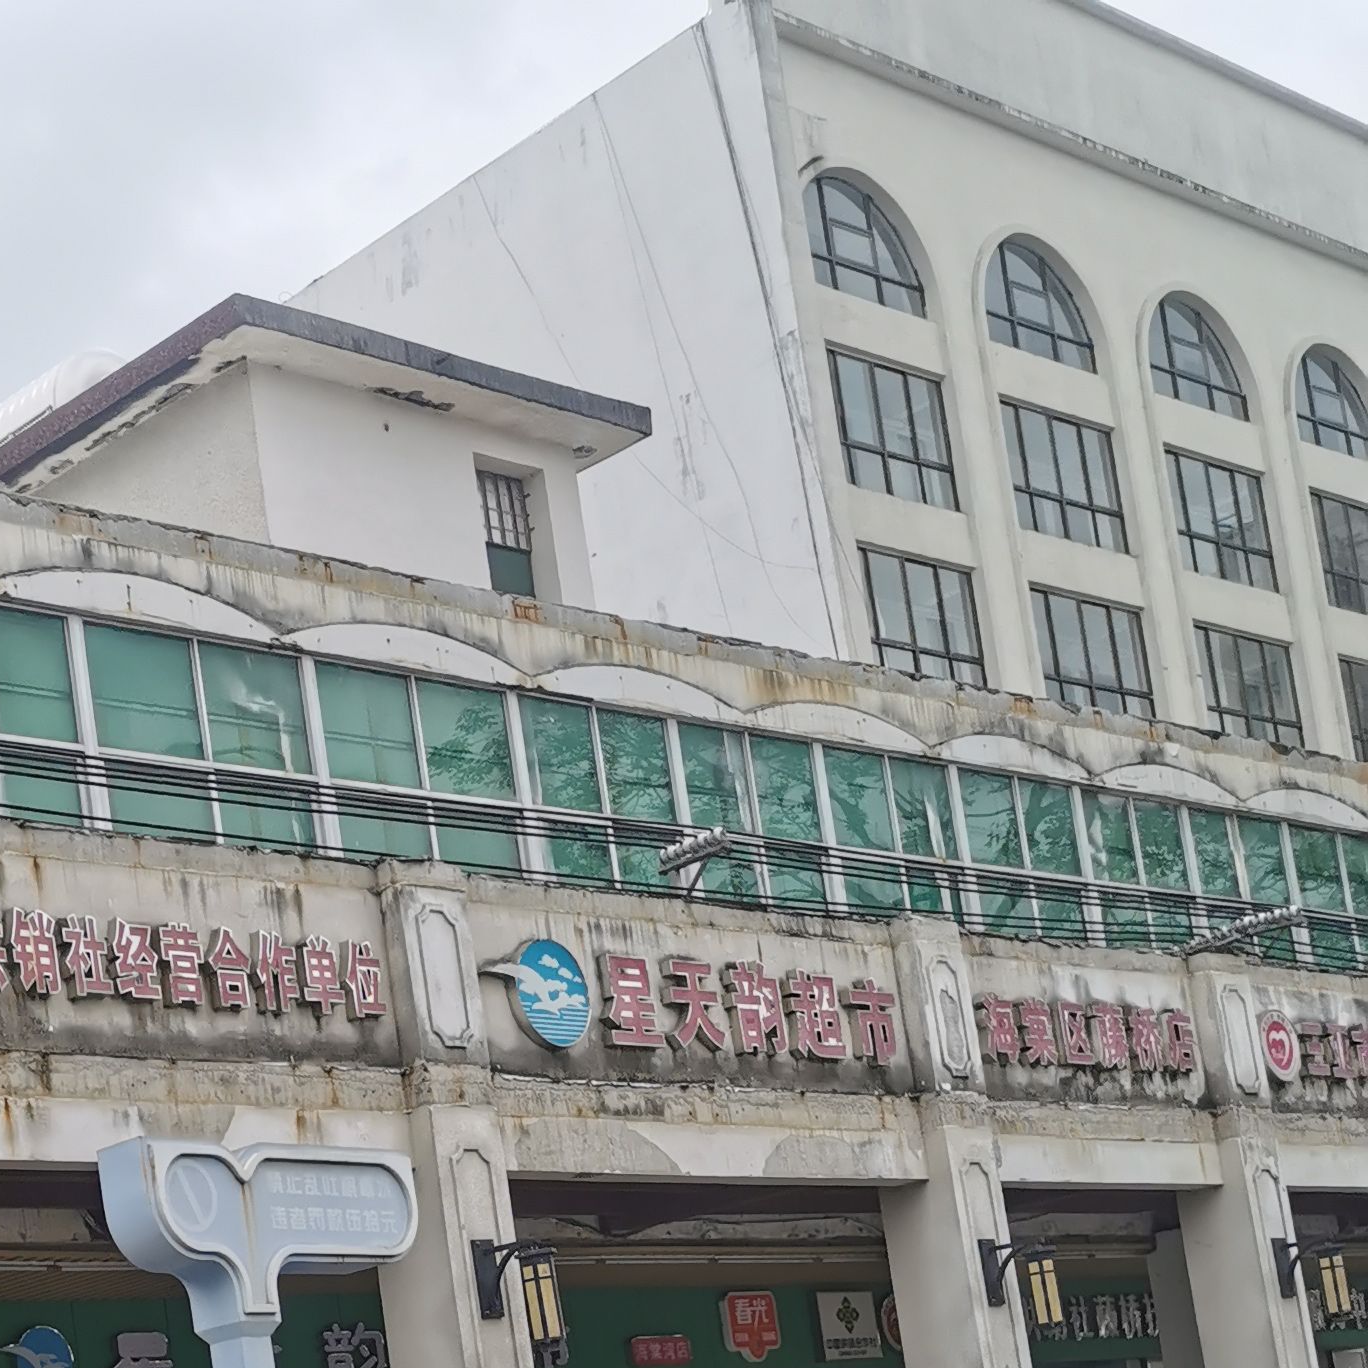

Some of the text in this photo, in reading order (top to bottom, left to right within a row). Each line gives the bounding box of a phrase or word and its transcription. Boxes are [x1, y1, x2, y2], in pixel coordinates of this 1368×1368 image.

[606, 952, 897, 1066] 星天韵超市
[983, 992, 1196, 1071] 海棠区藤桥店
